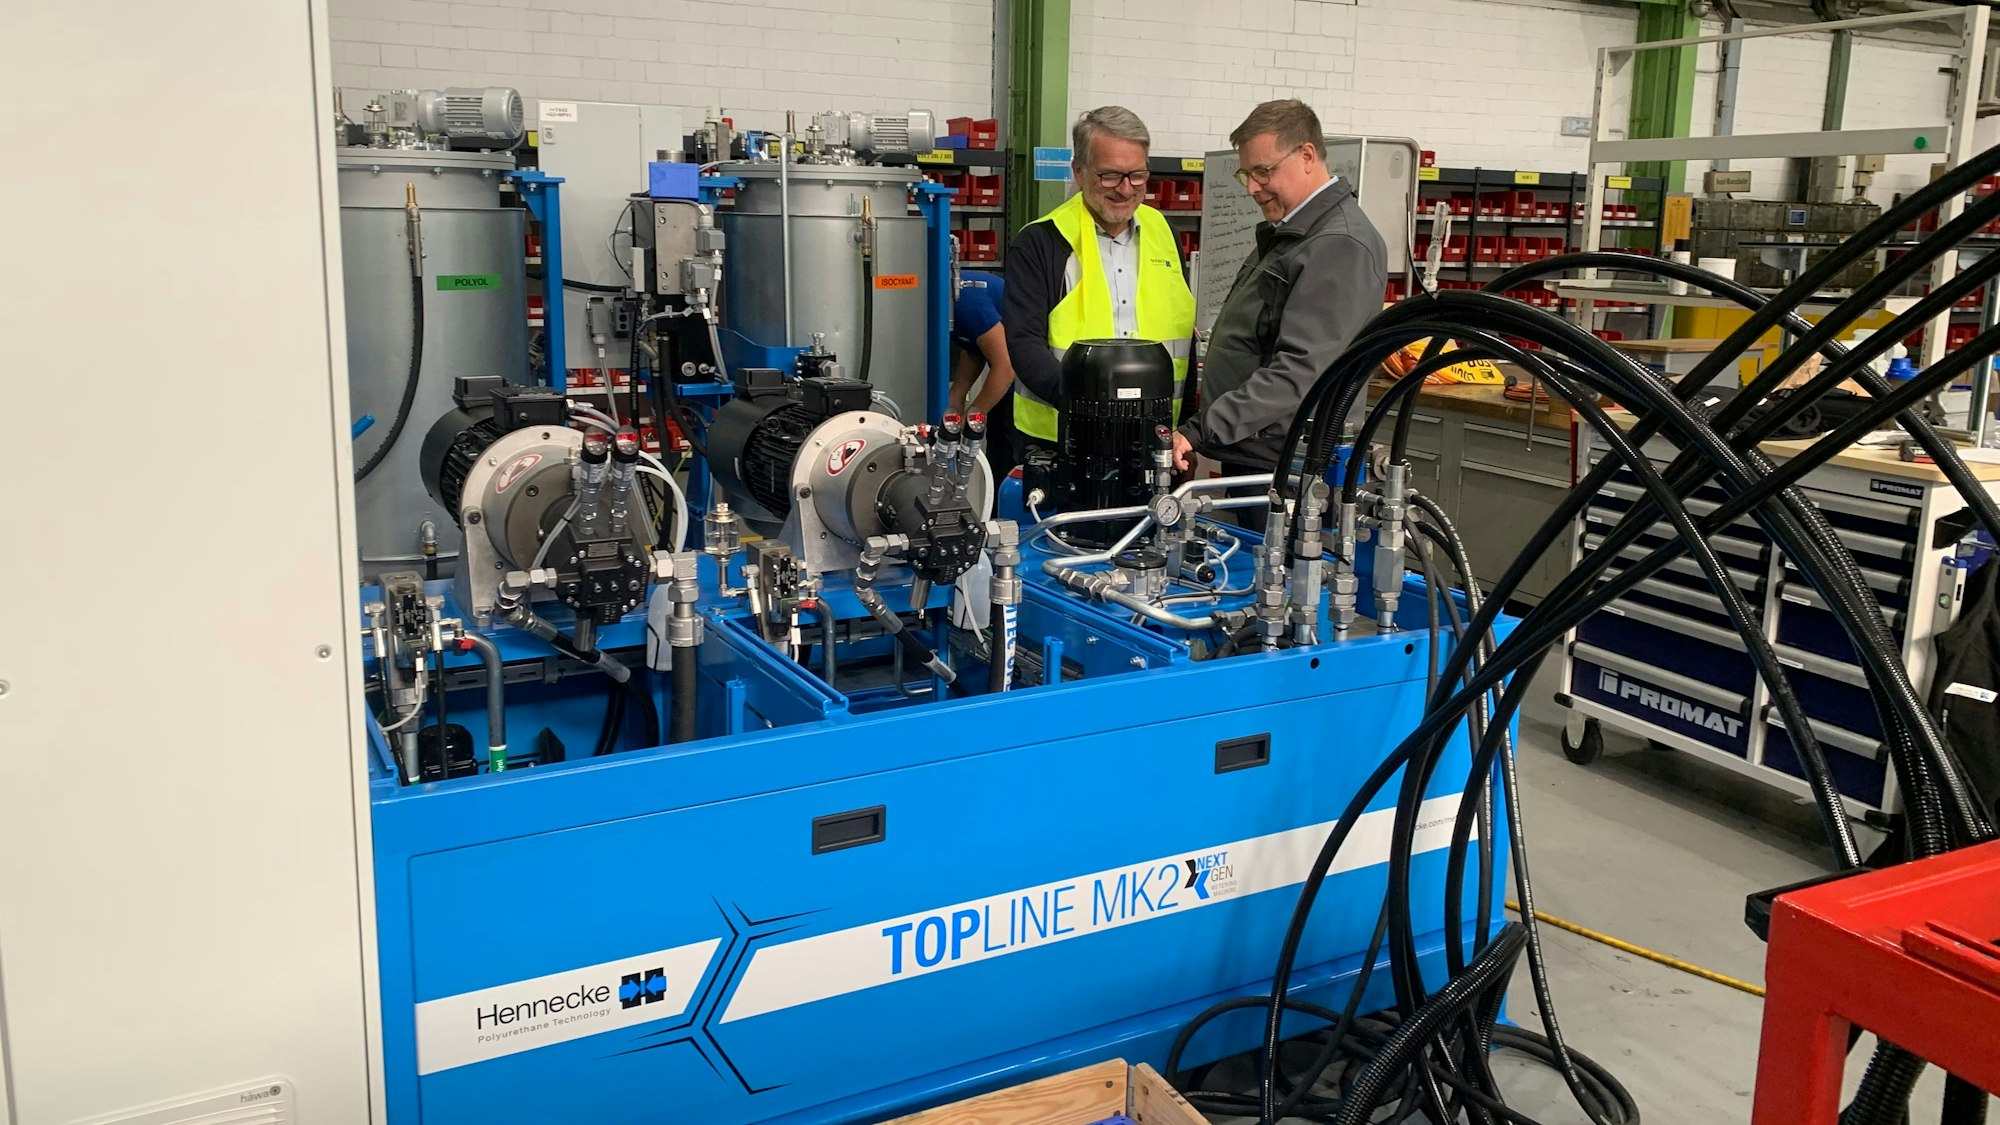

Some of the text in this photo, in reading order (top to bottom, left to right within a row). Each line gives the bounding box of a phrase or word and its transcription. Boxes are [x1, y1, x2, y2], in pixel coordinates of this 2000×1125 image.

[454, 278, 489, 287] POLYOL
[881, 277, 915, 286] ISOCYANAT
[1880, 484, 1922, 496] PROMAT
[1620, 680, 1743, 738] PROMAT
[1197, 851, 1228, 871] NEXT
[1211, 864, 1234, 882] GEN
[1523, 878, 1534, 917] HANSA-FLEX
[882, 863, 1180, 975] TOPLINE MK2
[477, 985, 611, 1029] Hennecke
[478, 1008, 611, 1043] Polyurethane Technology
